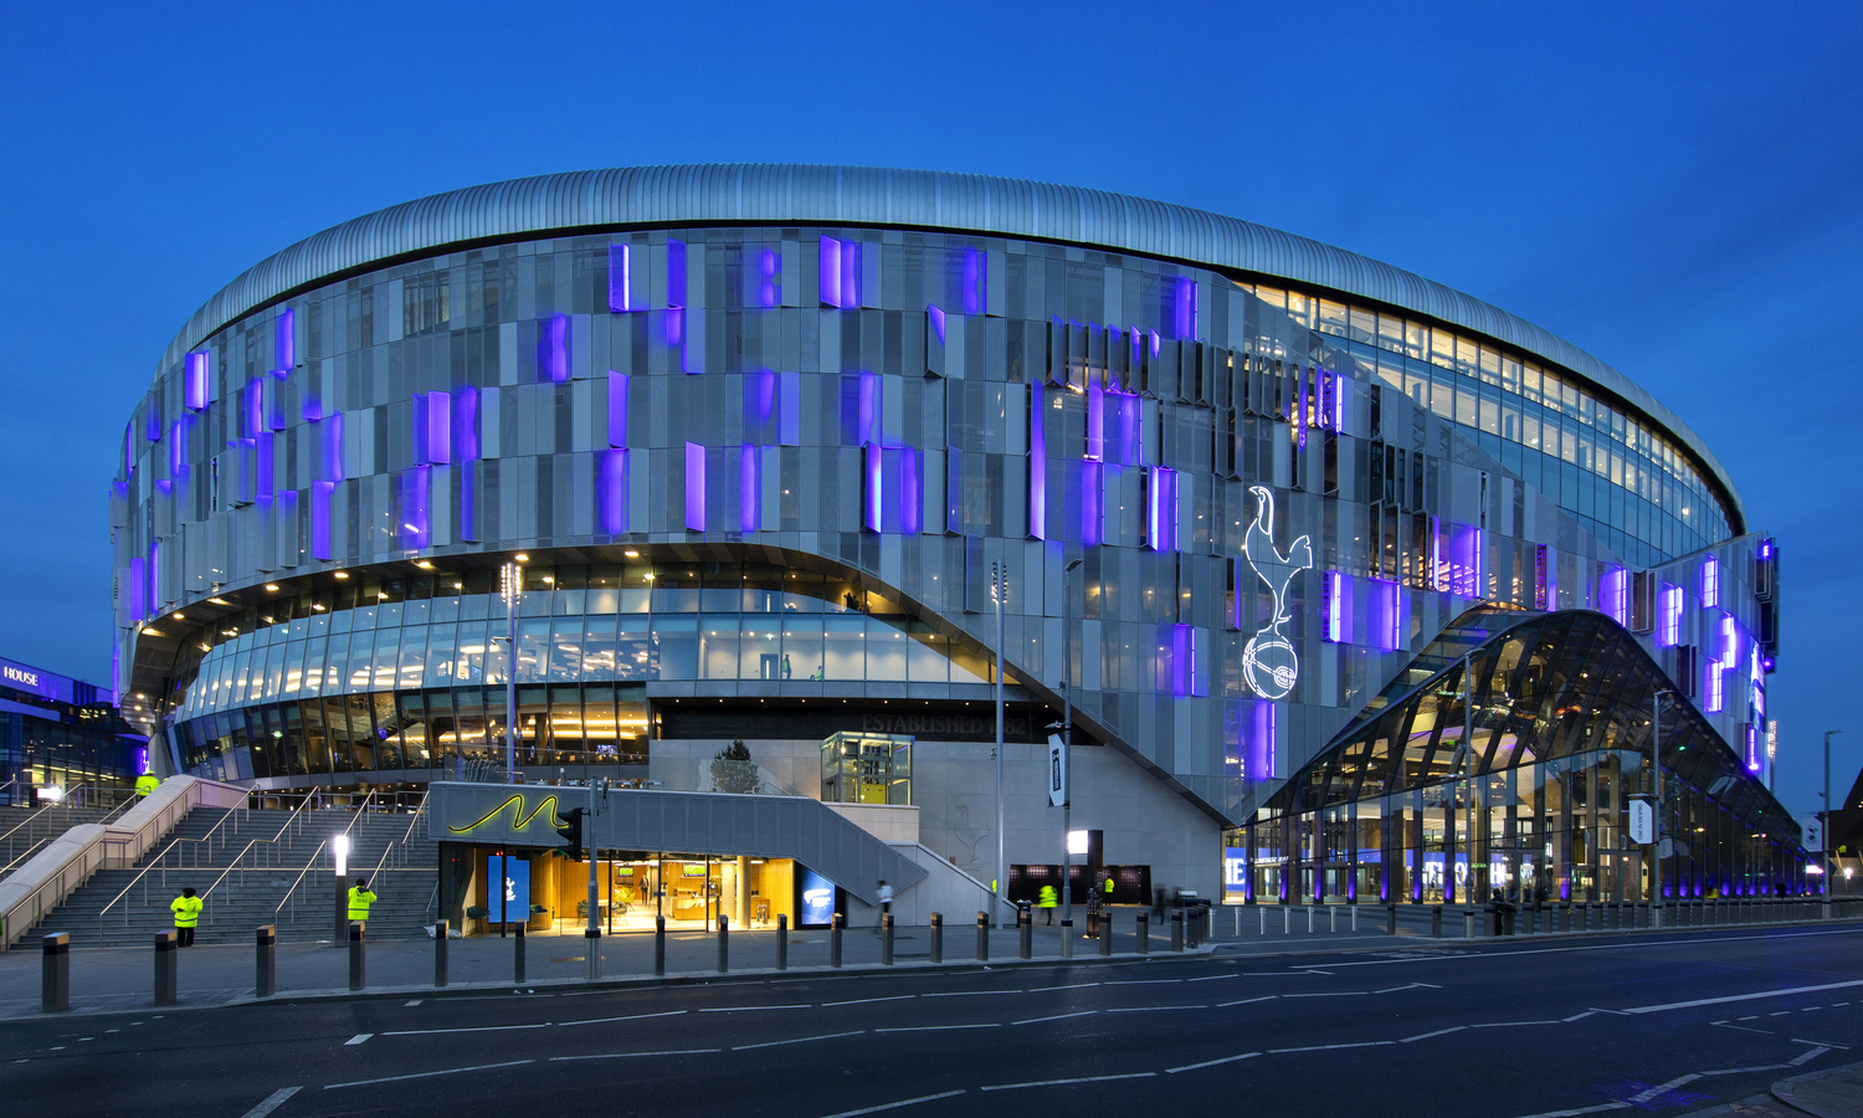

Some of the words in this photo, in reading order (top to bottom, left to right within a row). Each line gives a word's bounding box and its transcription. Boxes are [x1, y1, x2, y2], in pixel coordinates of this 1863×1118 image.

[4, 666, 38, 686] HOUSE
[862, 713, 983, 733] ESTABLISHED
[987, 716, 1026, 735] 182
